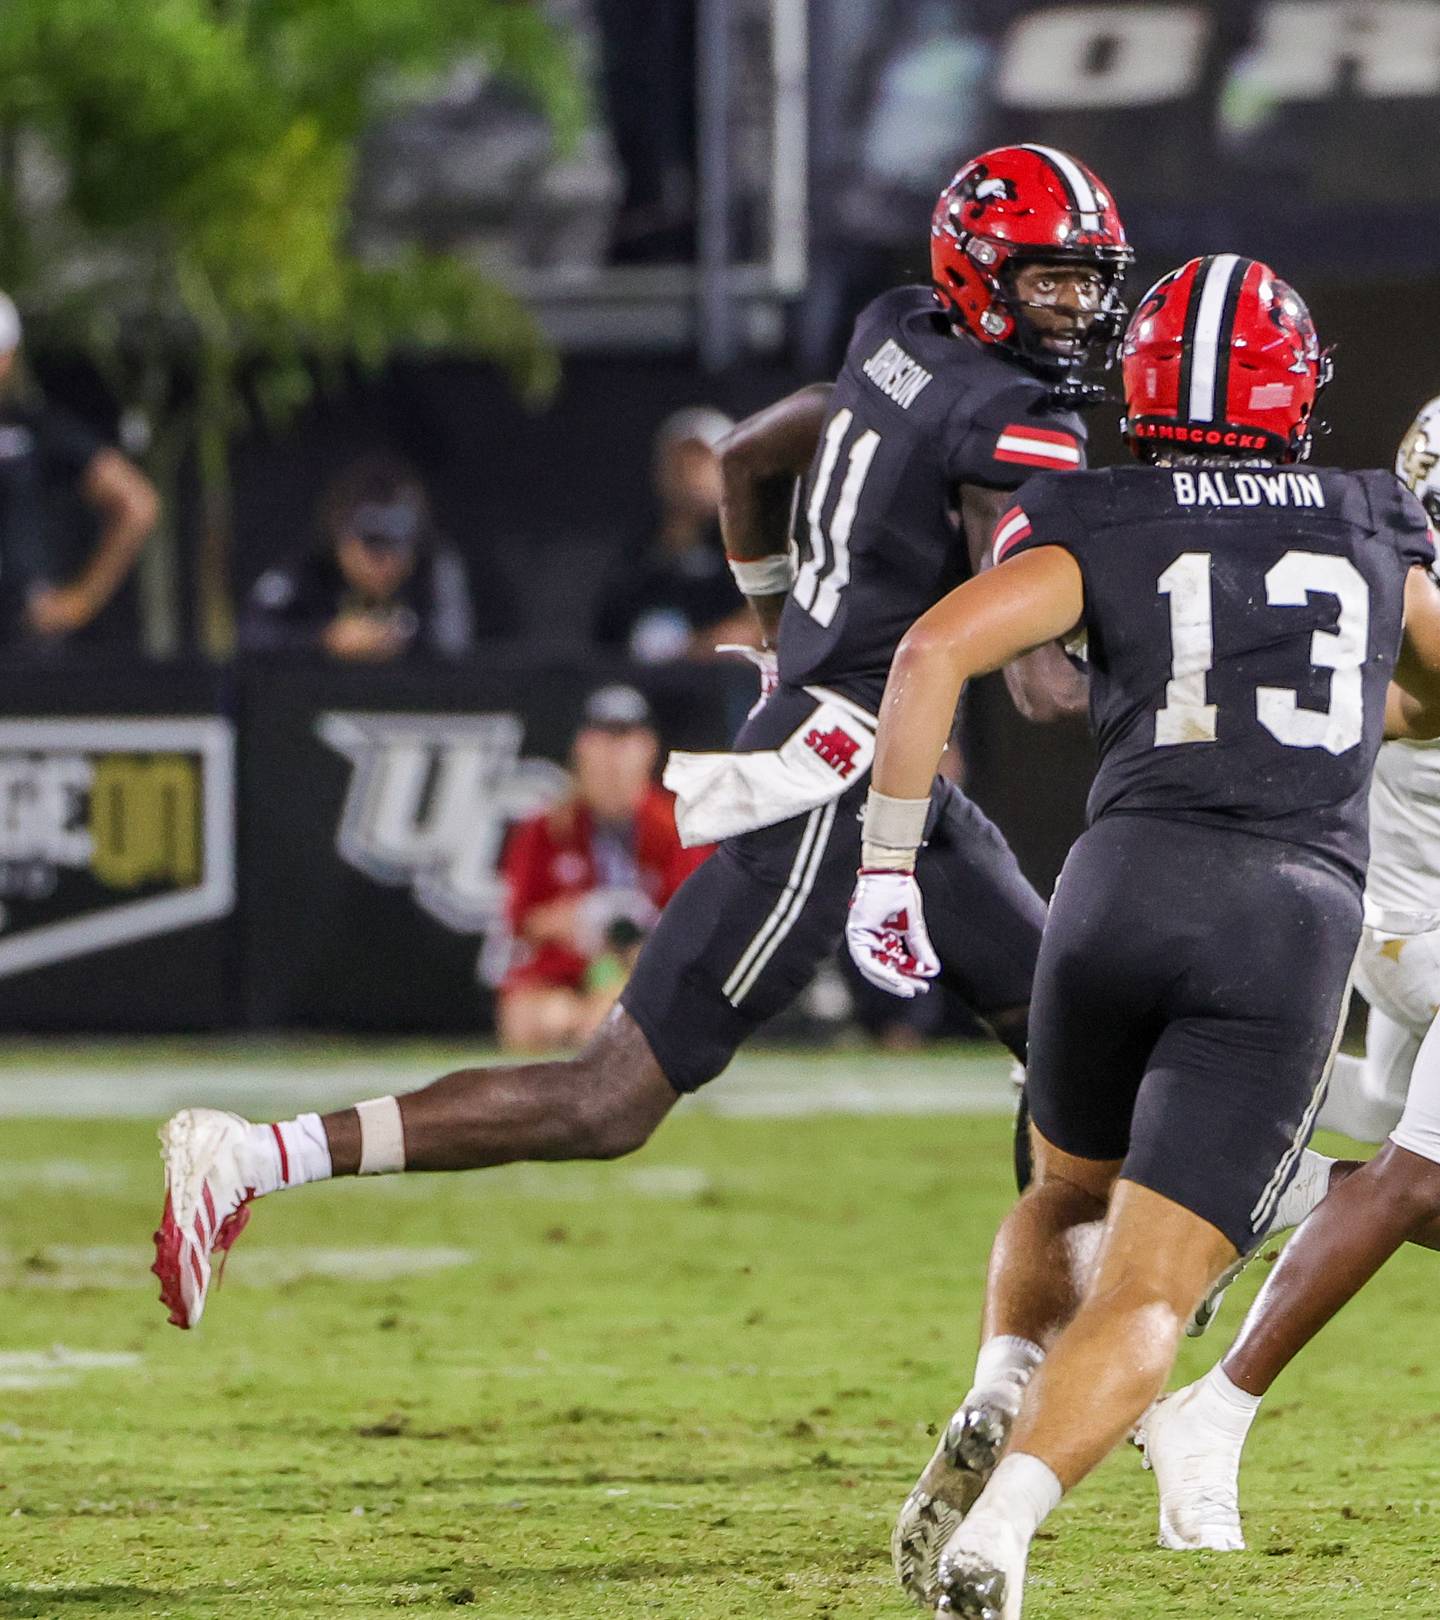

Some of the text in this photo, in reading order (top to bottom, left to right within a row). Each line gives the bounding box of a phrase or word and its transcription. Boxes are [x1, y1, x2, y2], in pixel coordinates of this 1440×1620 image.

[863, 338, 933, 410] JOHNSON
[793, 408, 881, 628] 11
[1172, 471, 1325, 508] BALDWIN
[1154, 551, 1370, 757] 13
